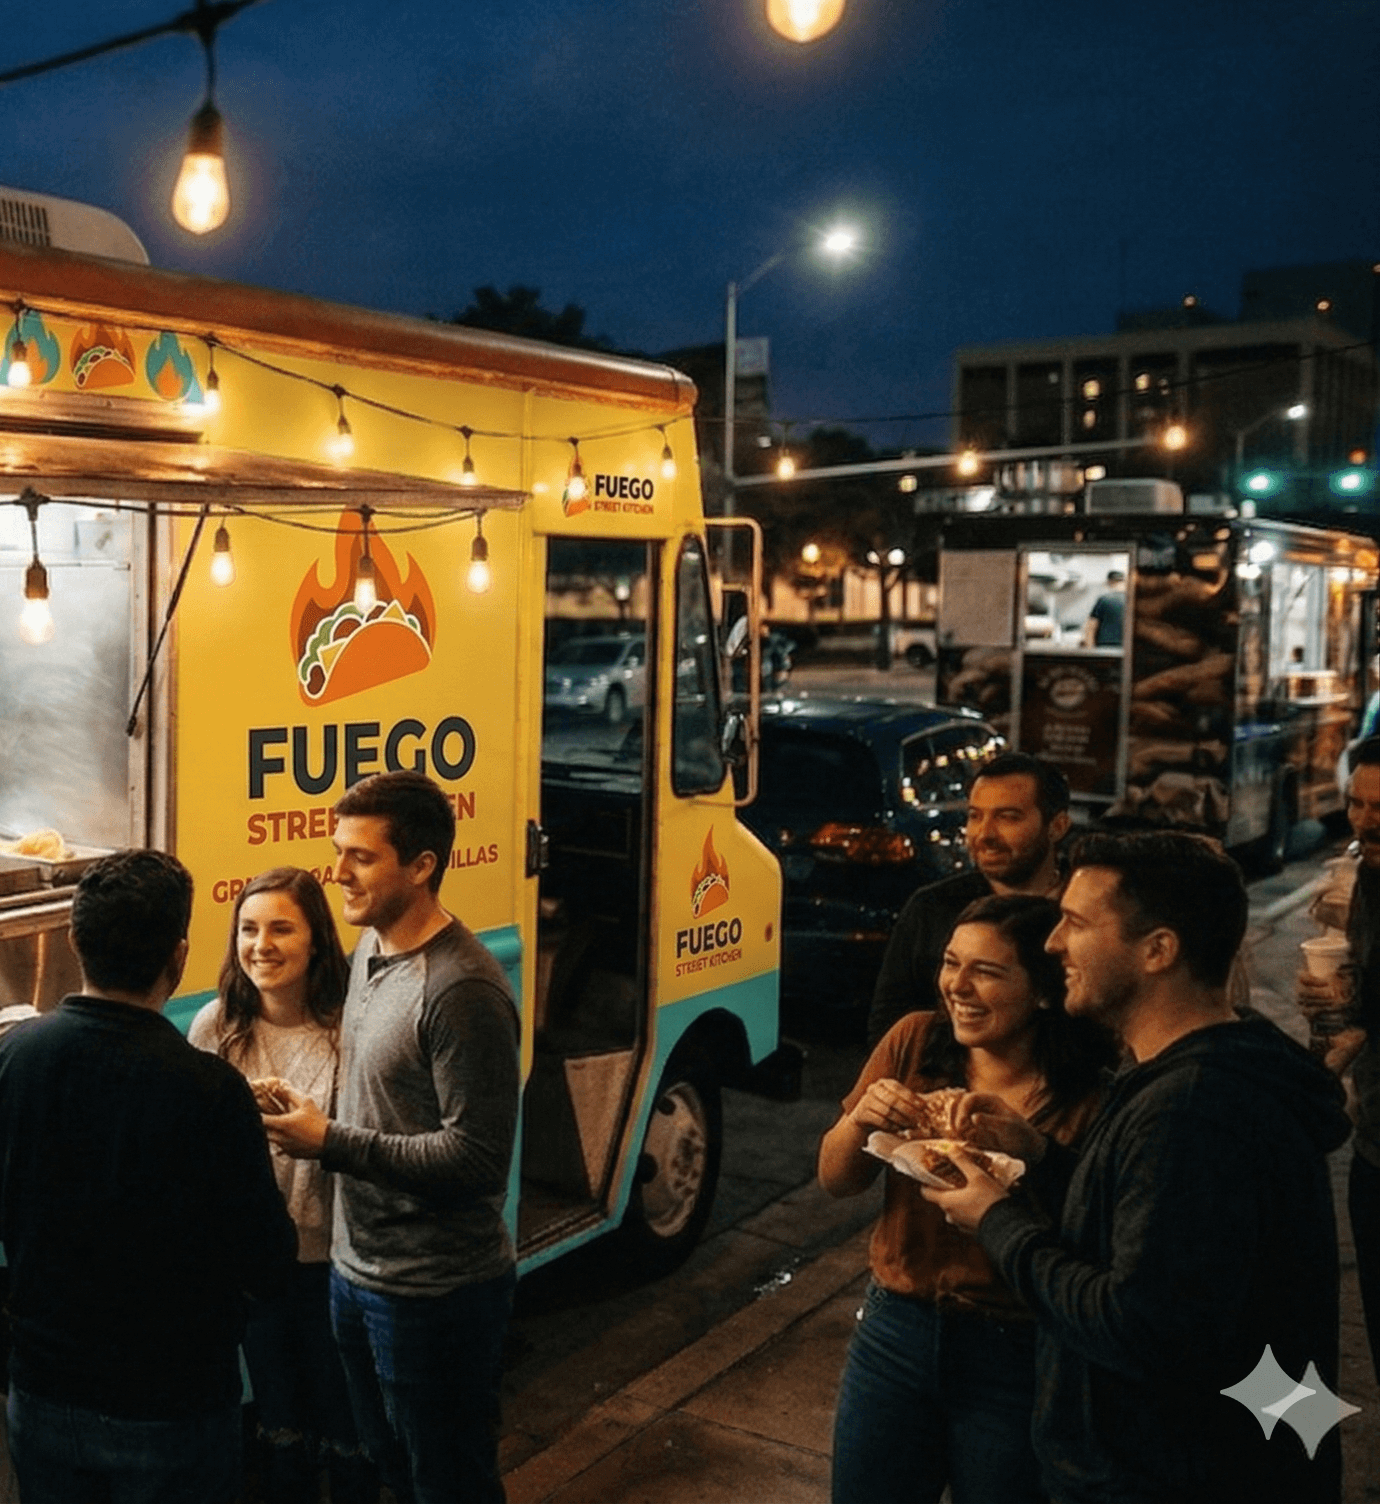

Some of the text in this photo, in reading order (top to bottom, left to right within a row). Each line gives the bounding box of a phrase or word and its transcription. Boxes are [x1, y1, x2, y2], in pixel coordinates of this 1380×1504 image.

[595, 474, 654, 500] FUEGO
[247, 715, 477, 800] FUEGO
[676, 917, 742, 959] FUEGO
